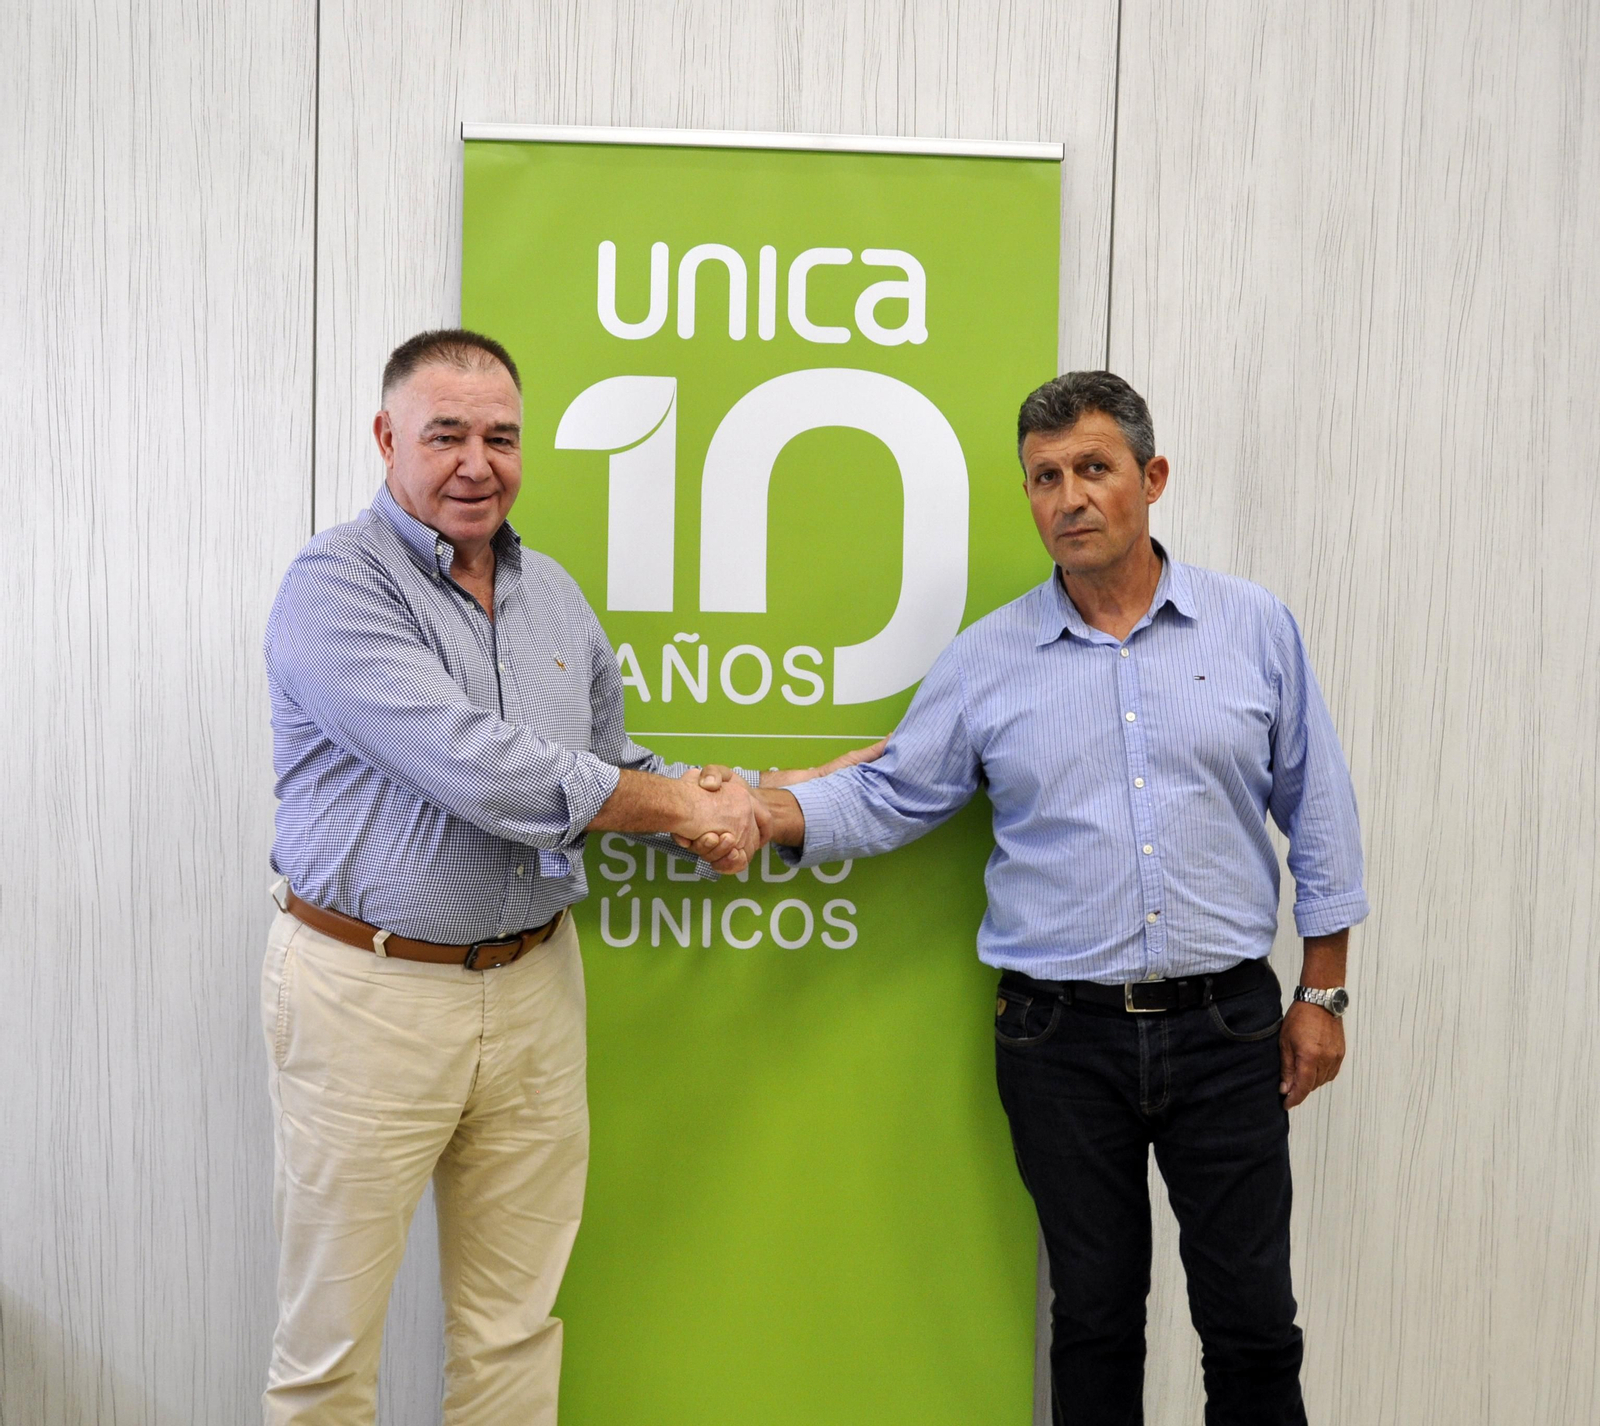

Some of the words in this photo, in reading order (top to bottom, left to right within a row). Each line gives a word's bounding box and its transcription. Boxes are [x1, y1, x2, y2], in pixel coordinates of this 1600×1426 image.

[554, 367, 970, 706] 10
[616, 632, 825, 706] AÑOS
[599, 832, 853, 883] SIED
[600, 884, 858, 950] ÚNICOS
